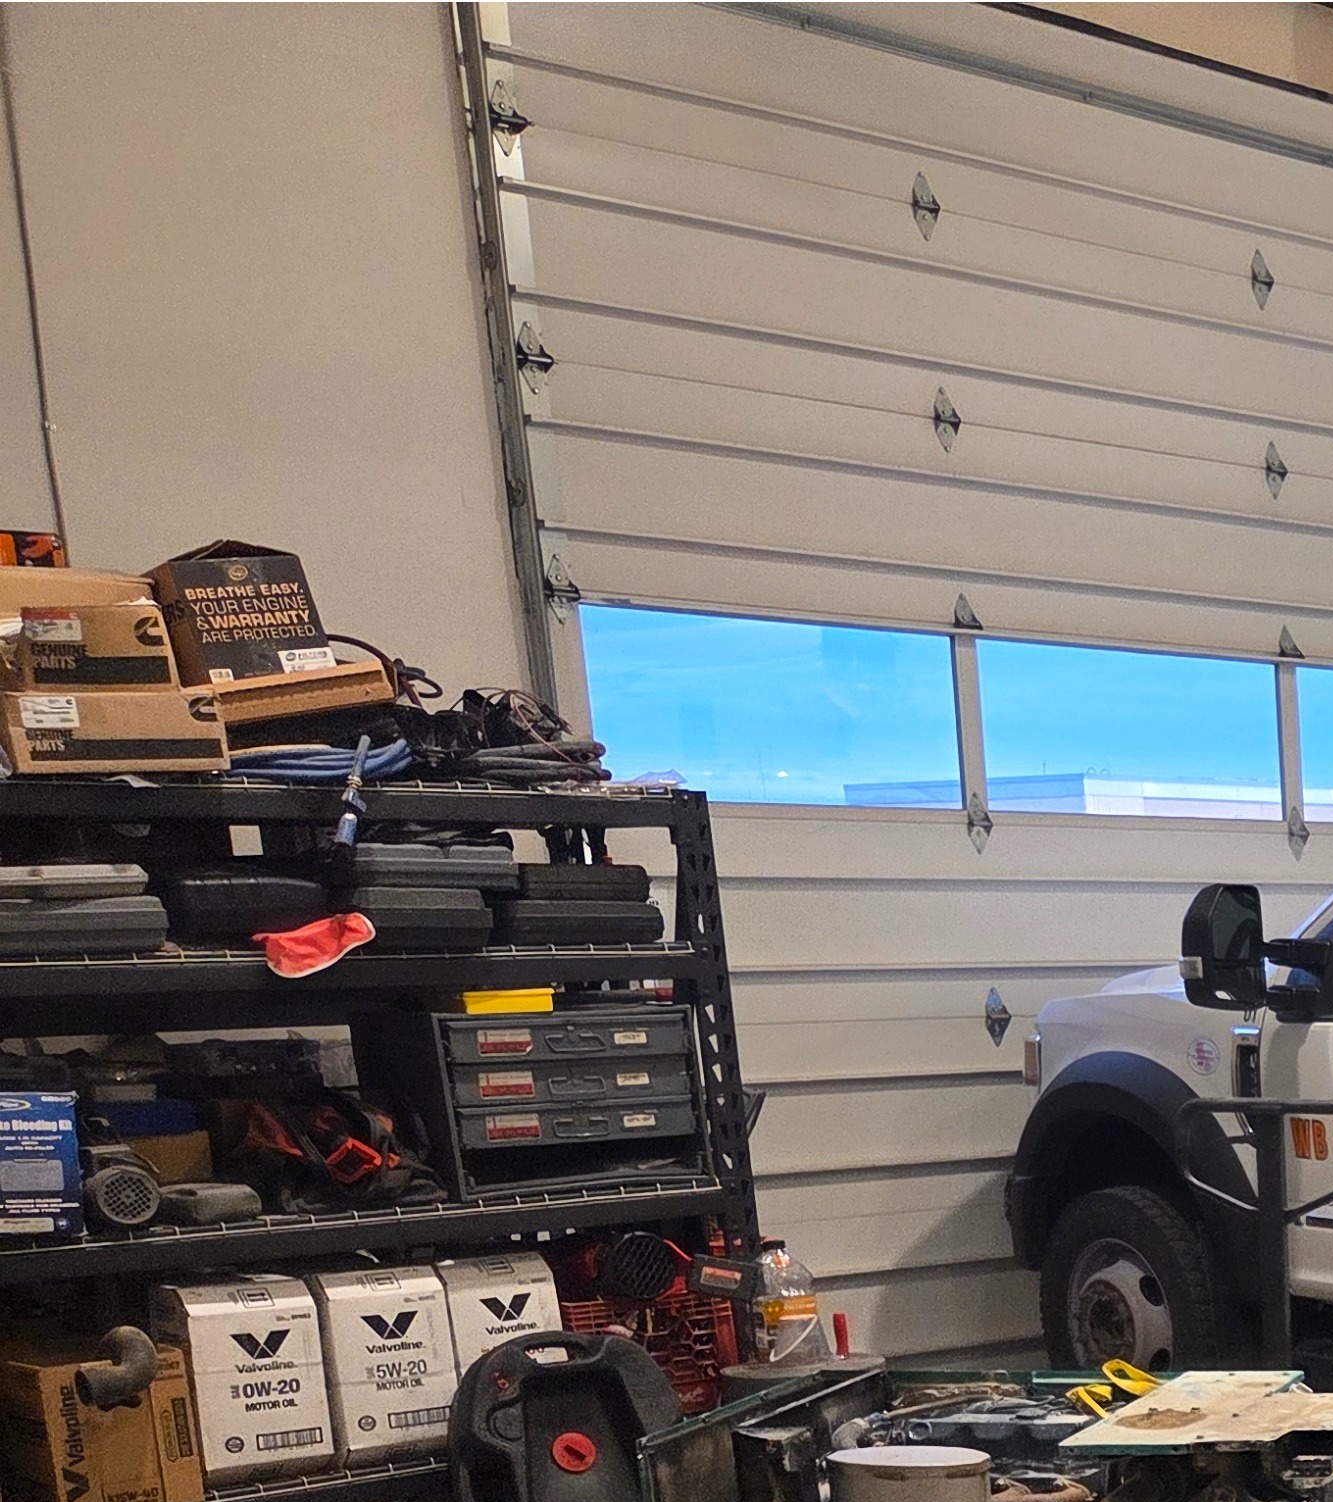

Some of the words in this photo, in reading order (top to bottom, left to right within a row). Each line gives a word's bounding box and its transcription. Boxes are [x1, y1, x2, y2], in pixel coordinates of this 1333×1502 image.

[184, 584, 256, 600] BREATHE
[260, 582, 304, 595] EASY.
[189, 600, 240, 616] YOUR
[243, 595, 309, 612] ENGINE
[202, 630, 233, 644] ARE
[32, 655, 77, 670] PARTS
[28, 740, 66, 752] PARTS
[1289, 1116, 1329, 1161] WB
[485, 1322, 537, 1335] Valvoline
[365, 1340, 423, 1354] Valvoline
[235, 1361, 299, 1375] Valvoline
[376, 1359, 427, 1379] 5W-20
[242, 1378, 301, 1399] 0W-20
[375, 1380, 410, 1392] MOTOR
[410, 1378, 425, 1388] OIL
[245, 1400, 281, 1413] MOTOR
[282, 1398, 298, 1408] OIL
[59, 1382, 86, 1467] Valvoline
